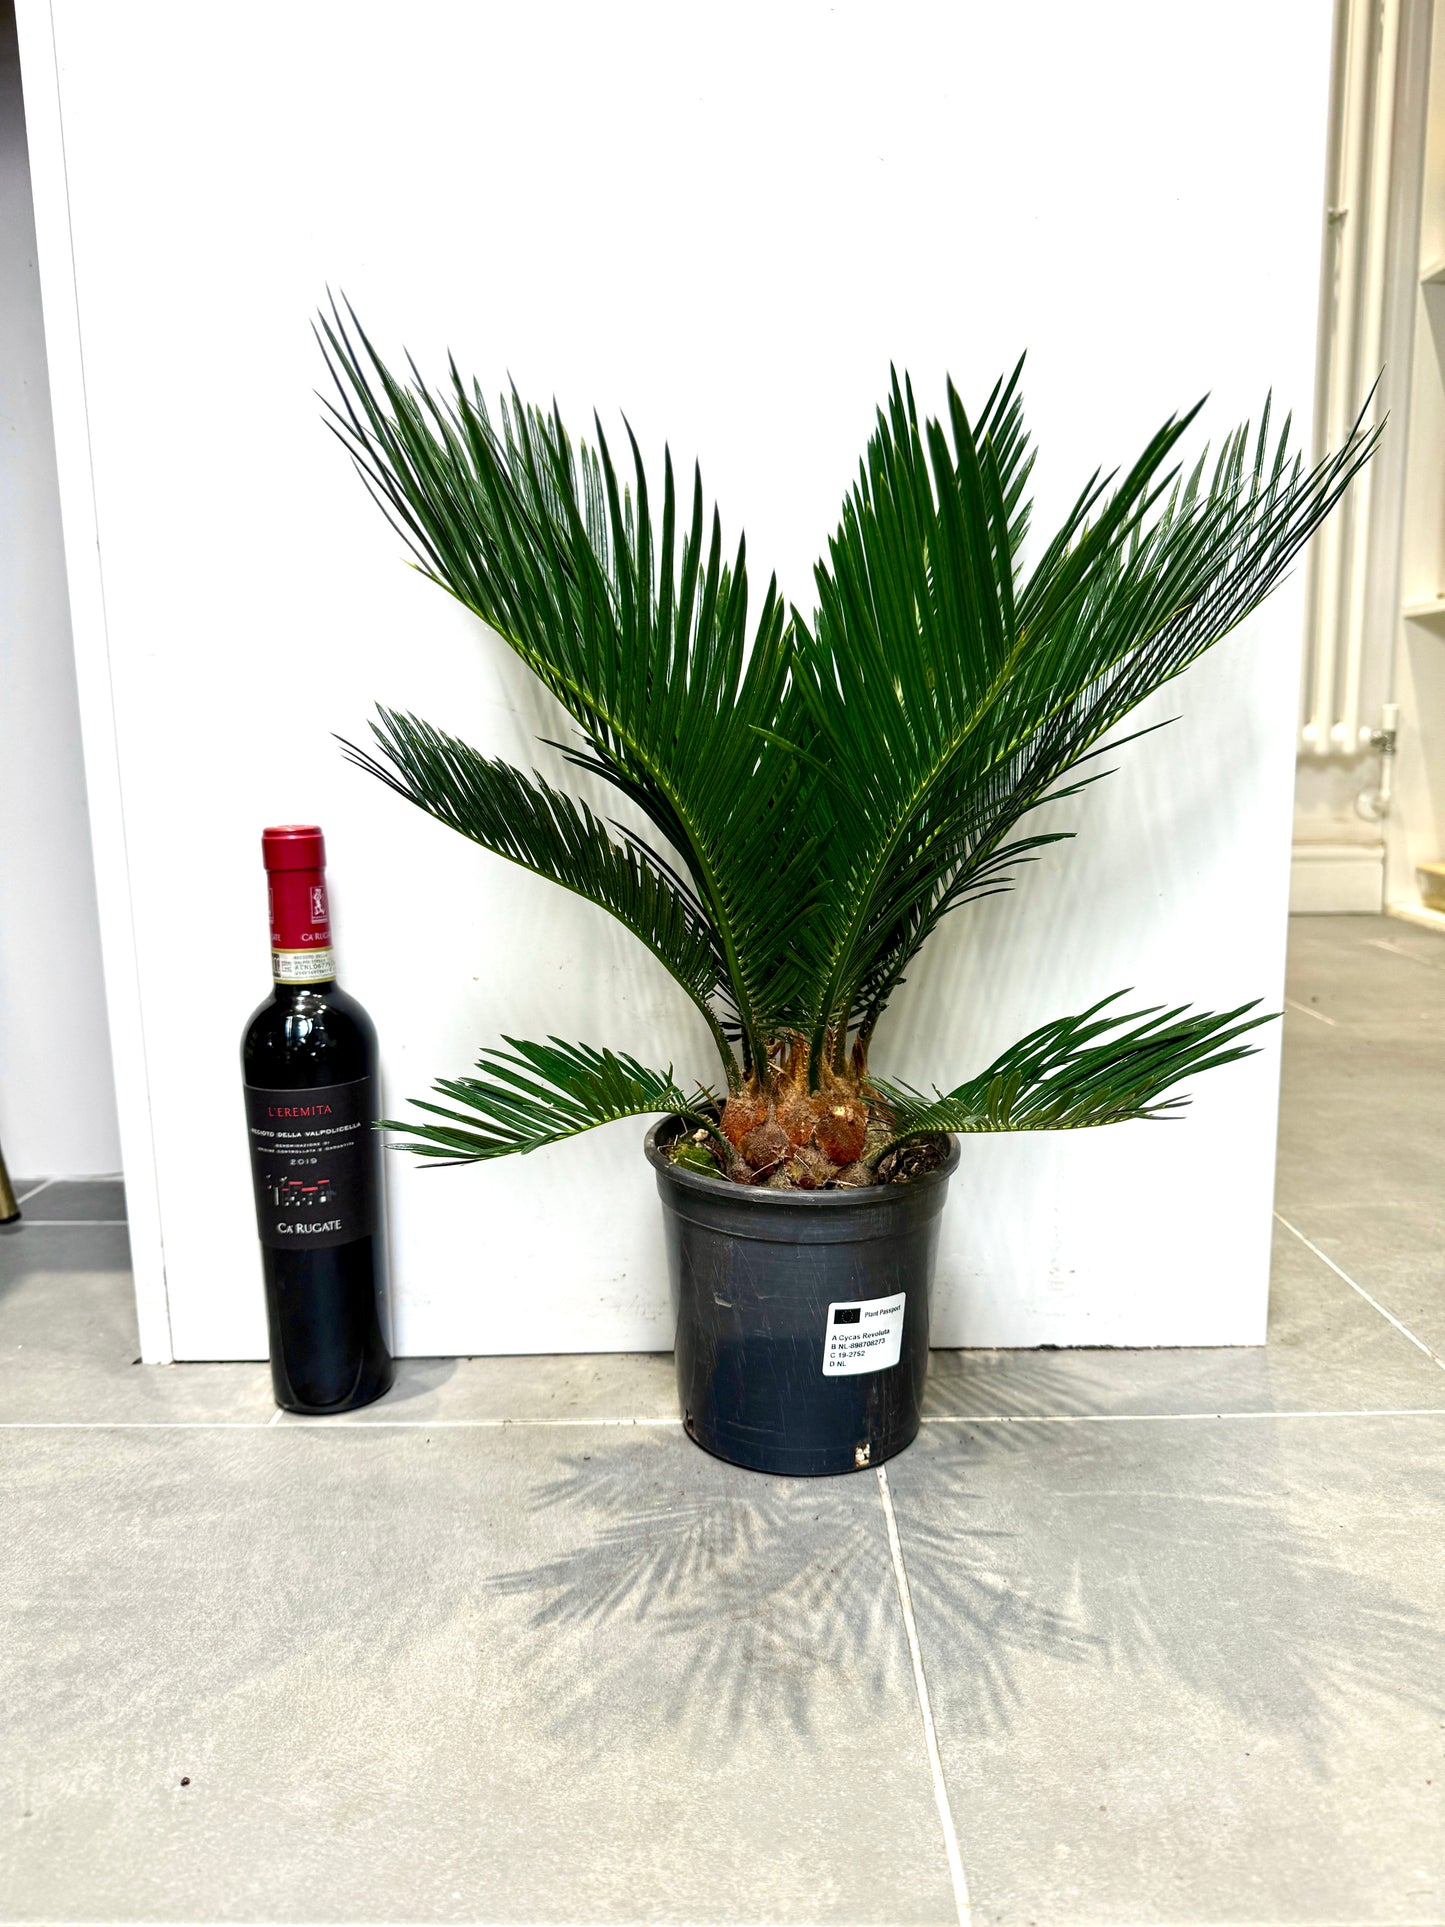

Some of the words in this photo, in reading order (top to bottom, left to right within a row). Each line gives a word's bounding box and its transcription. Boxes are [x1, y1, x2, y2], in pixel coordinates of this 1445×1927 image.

[267, 1105, 332, 1117] L'EREMITA
[305, 1122, 361, 1136] VALPOLICELLA
[289, 1157, 318, 1166] 2019
[295, 1219, 342, 1233] RUGATE
[864, 1310, 879, 1318] Plant
[879, 1304, 901, 1314] Passport
[838, 1334, 861, 1342] Cycas
[862, 1329, 890, 1339] Revoluta
[838, 1350, 866, 1359] 19-2752
